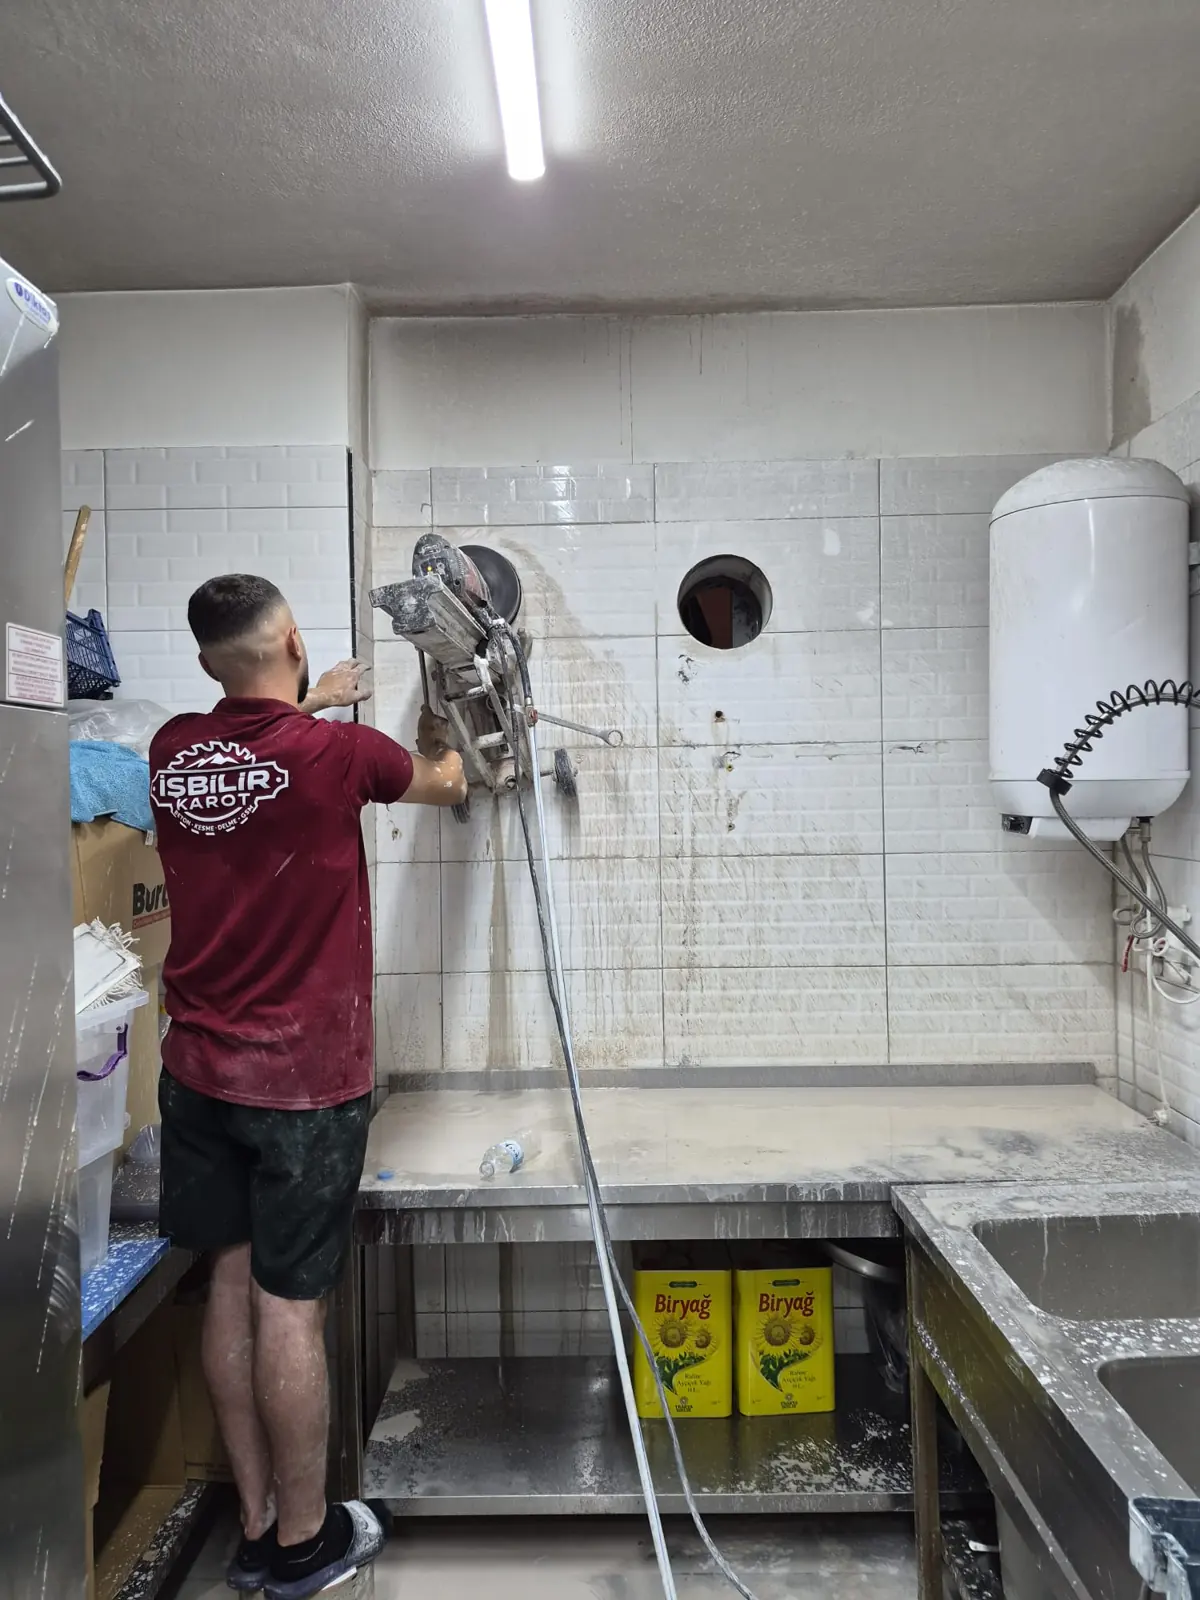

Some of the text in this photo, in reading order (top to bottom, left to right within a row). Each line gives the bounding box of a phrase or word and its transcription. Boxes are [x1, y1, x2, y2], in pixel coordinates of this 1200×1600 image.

[176, 793, 251, 811] KAROT
[173, 804, 254, 832] BETON KESME DELME GSM
[654, 1293, 712, 1320] Biryağ
[759, 1291, 815, 1318] Biryağ
